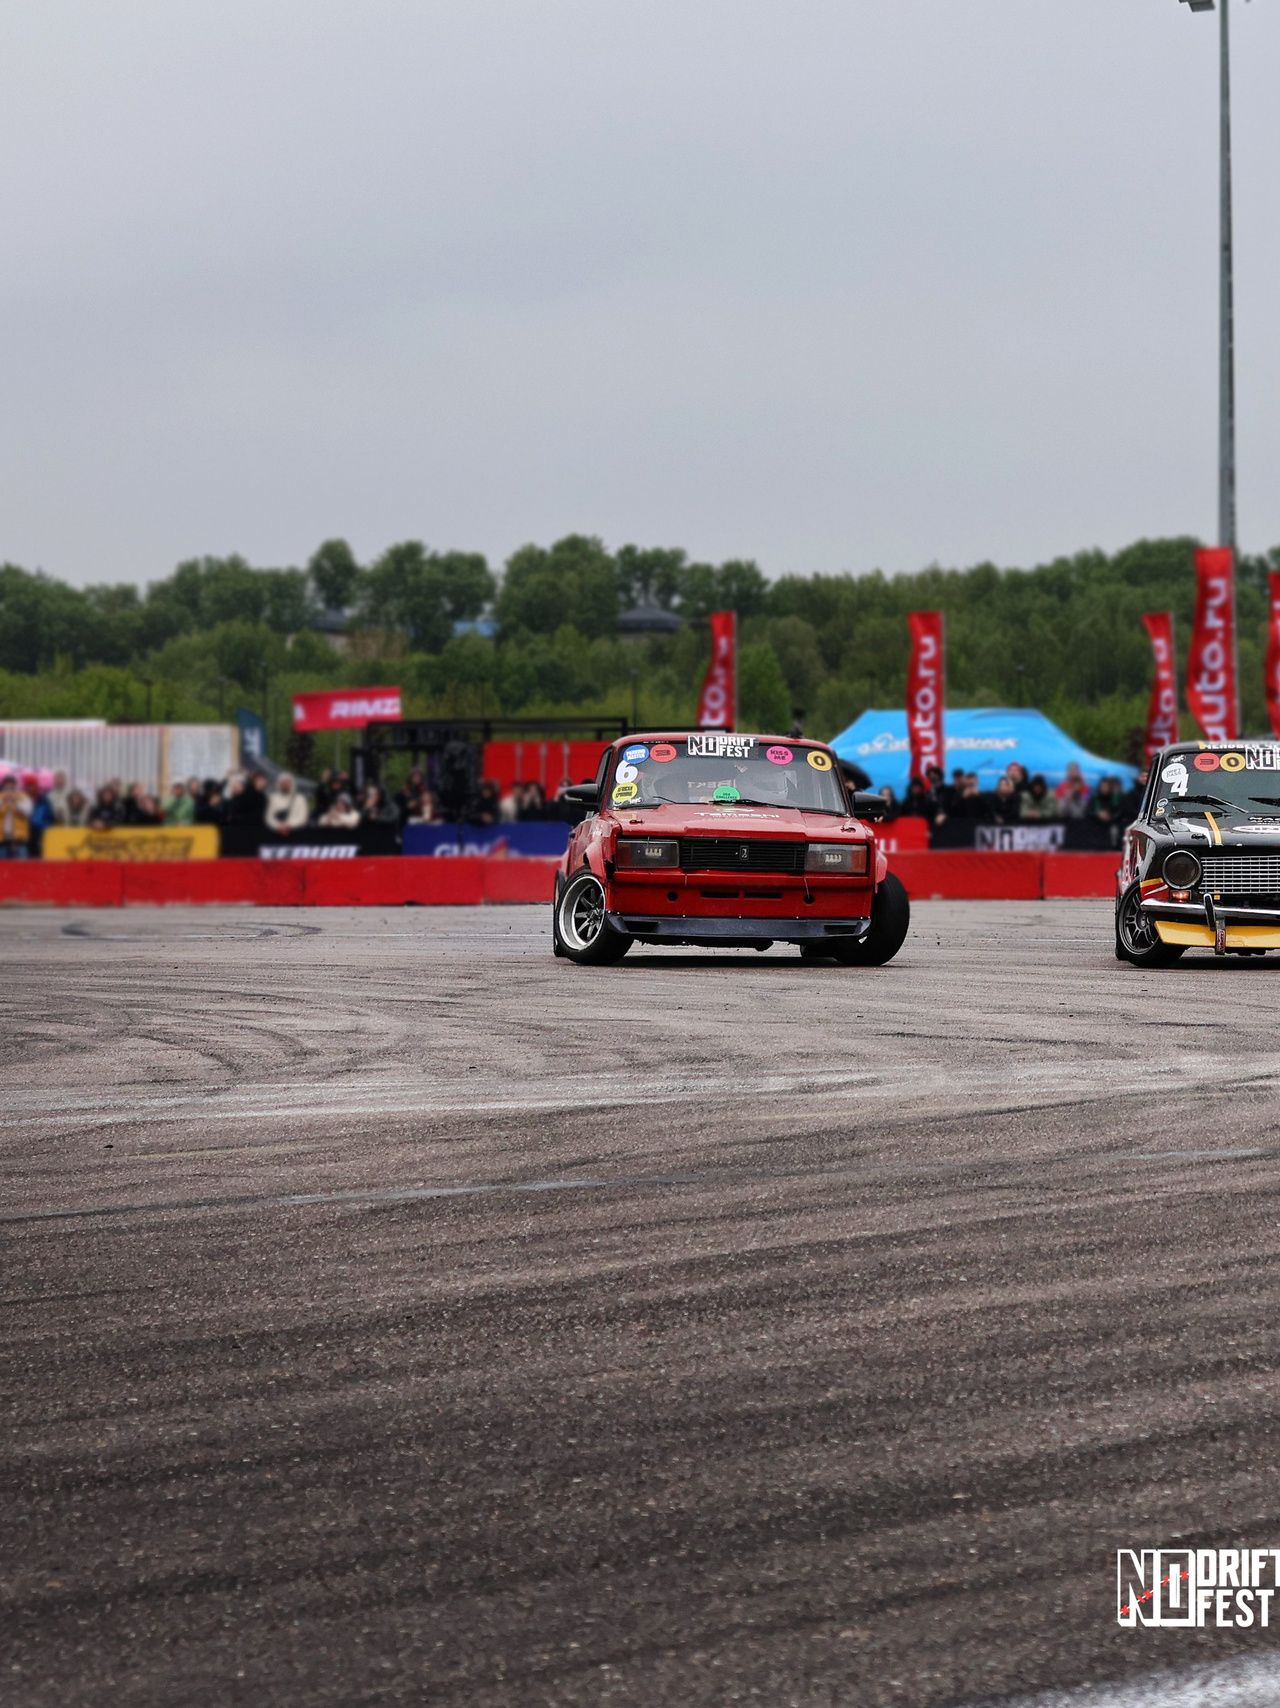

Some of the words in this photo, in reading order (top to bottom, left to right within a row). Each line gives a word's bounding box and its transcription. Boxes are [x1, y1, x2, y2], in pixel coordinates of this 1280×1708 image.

[720, 736, 756, 747] DRIFT
[720, 745, 751, 758] FEST
[615, 760, 639, 784] 6
[1171, 774, 1189, 797] 4
